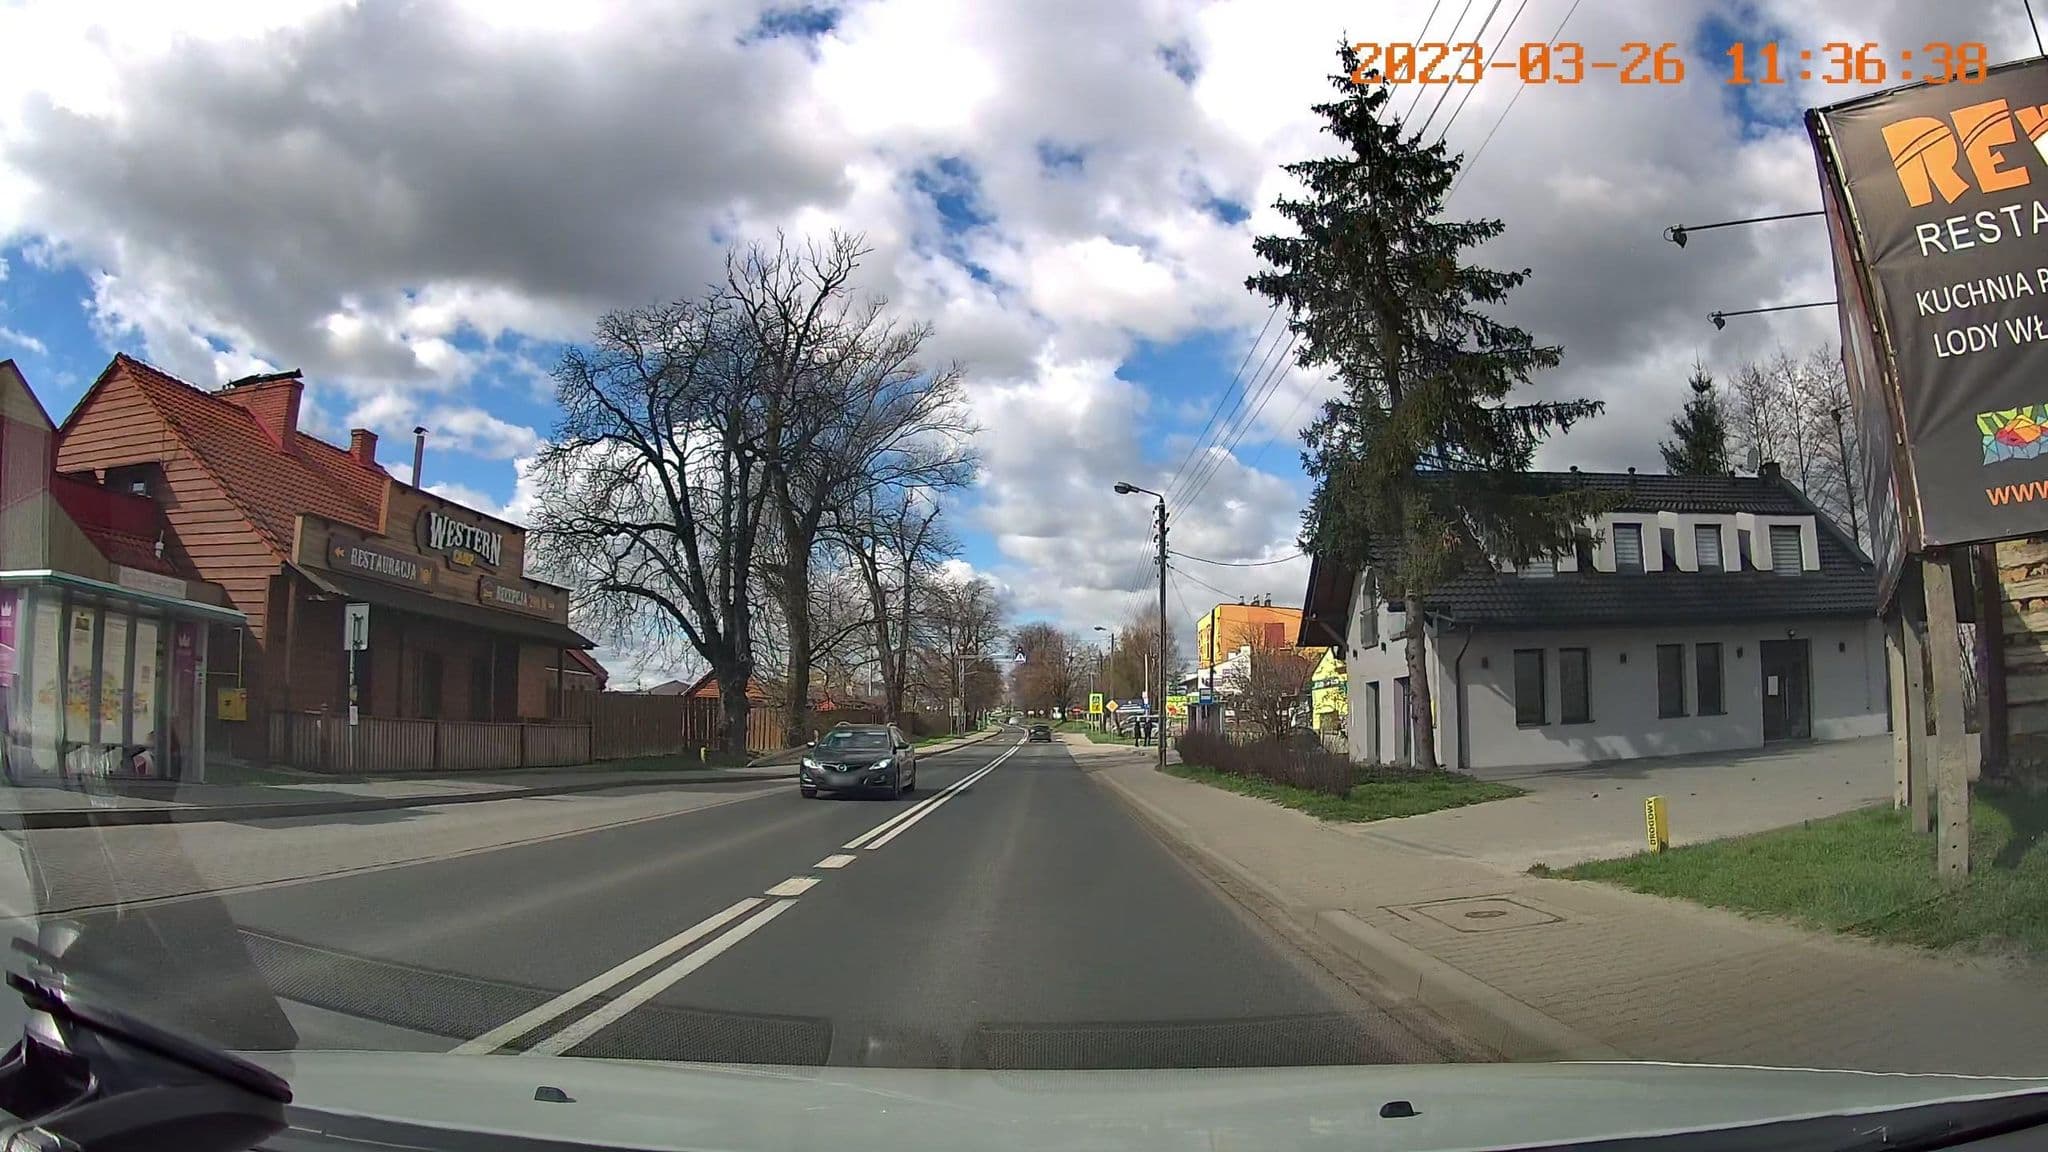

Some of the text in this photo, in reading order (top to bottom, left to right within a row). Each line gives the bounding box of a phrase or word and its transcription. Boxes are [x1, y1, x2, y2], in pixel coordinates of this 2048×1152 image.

[1916, 272, 2035, 316] KUCHNIA
[1934, 315, 2048, 358] LODY WŁ
[430, 512, 502, 566] WESTERN
[351, 548, 417, 580] RESTAURACJA
